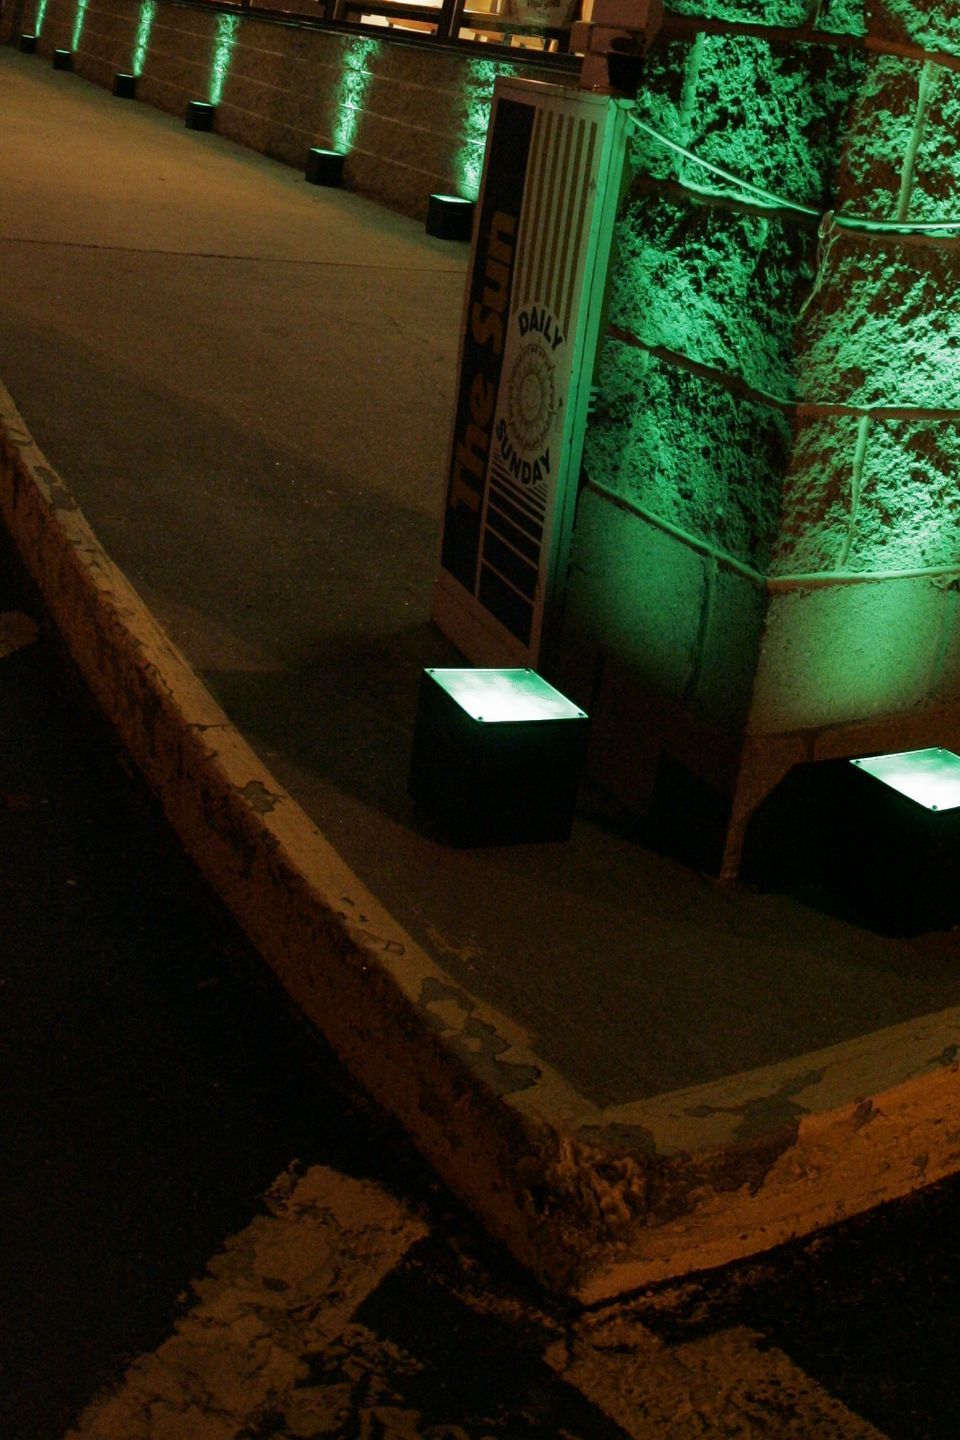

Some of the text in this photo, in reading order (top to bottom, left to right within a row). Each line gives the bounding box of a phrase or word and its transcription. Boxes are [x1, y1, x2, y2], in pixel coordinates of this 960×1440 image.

[451, 211, 516, 511] The Sun
[518, 307, 562, 350] DAILY
[498, 418, 550, 485] SUNDAY
